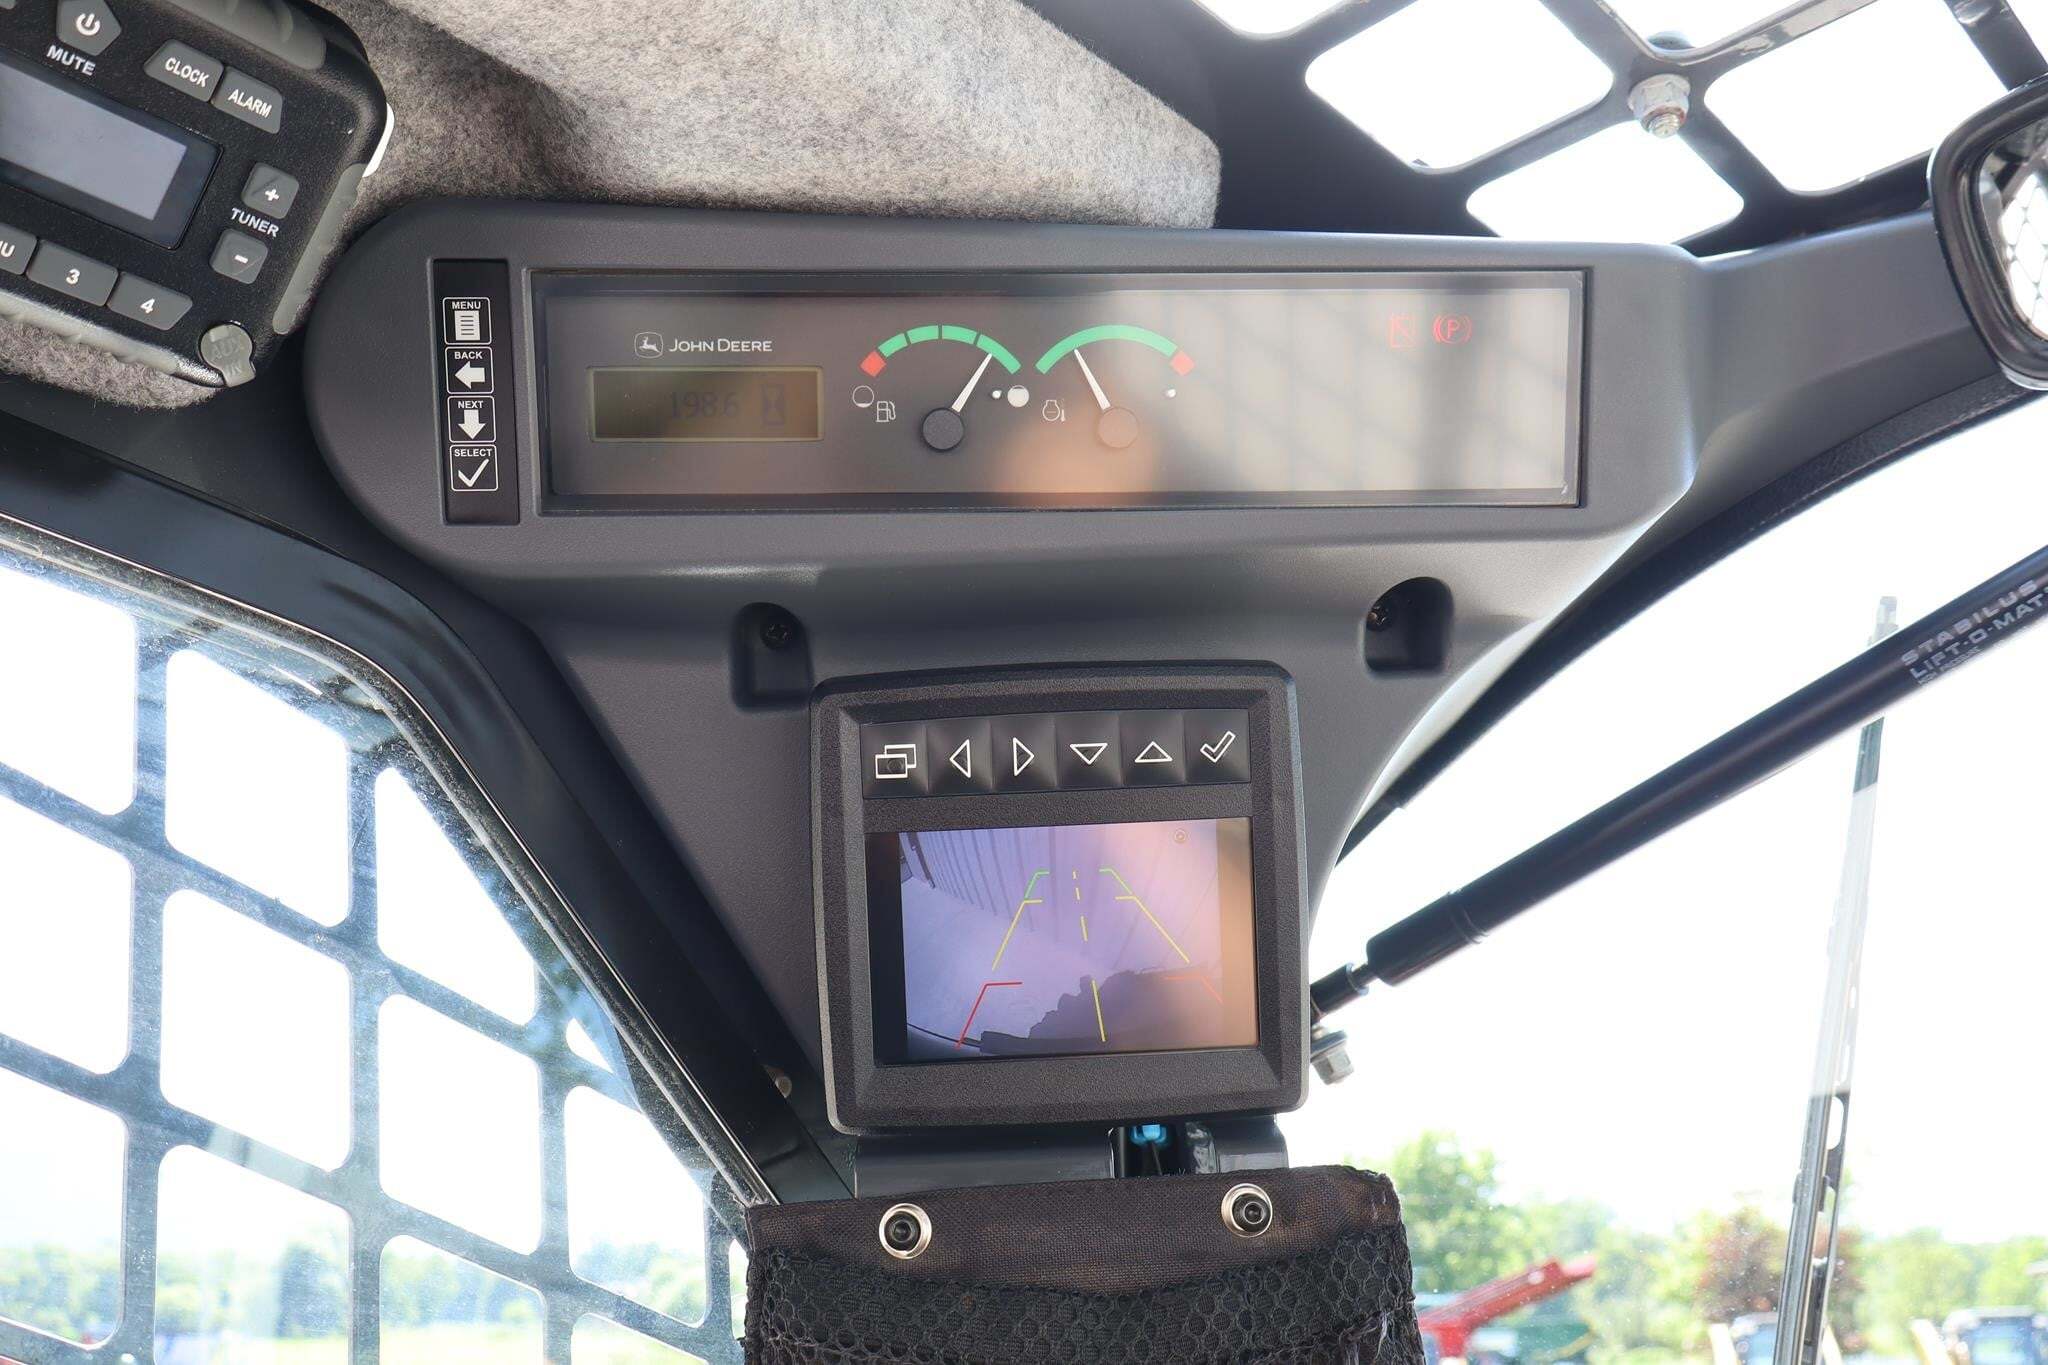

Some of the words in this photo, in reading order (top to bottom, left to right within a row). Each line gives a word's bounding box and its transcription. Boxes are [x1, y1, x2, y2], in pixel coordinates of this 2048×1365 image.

[46, 44, 96, 76] MUTE
[164, 56, 210, 88] CLOCK
[228, 89, 272, 118] ALARM
[230, 207, 279, 238] TUNER
[66, 268, 80, 285] 3
[140, 298, 155, 314] 4
[451, 301, 481, 310] MENU
[669, 338, 714, 352] JOHN
[717, 338, 773, 352] DEERE
[454, 351, 483, 360] BACK
[457, 400, 484, 409] NEXT
[454, 448, 493, 457] SELECT
[1901, 579, 2038, 666] STABILUS
